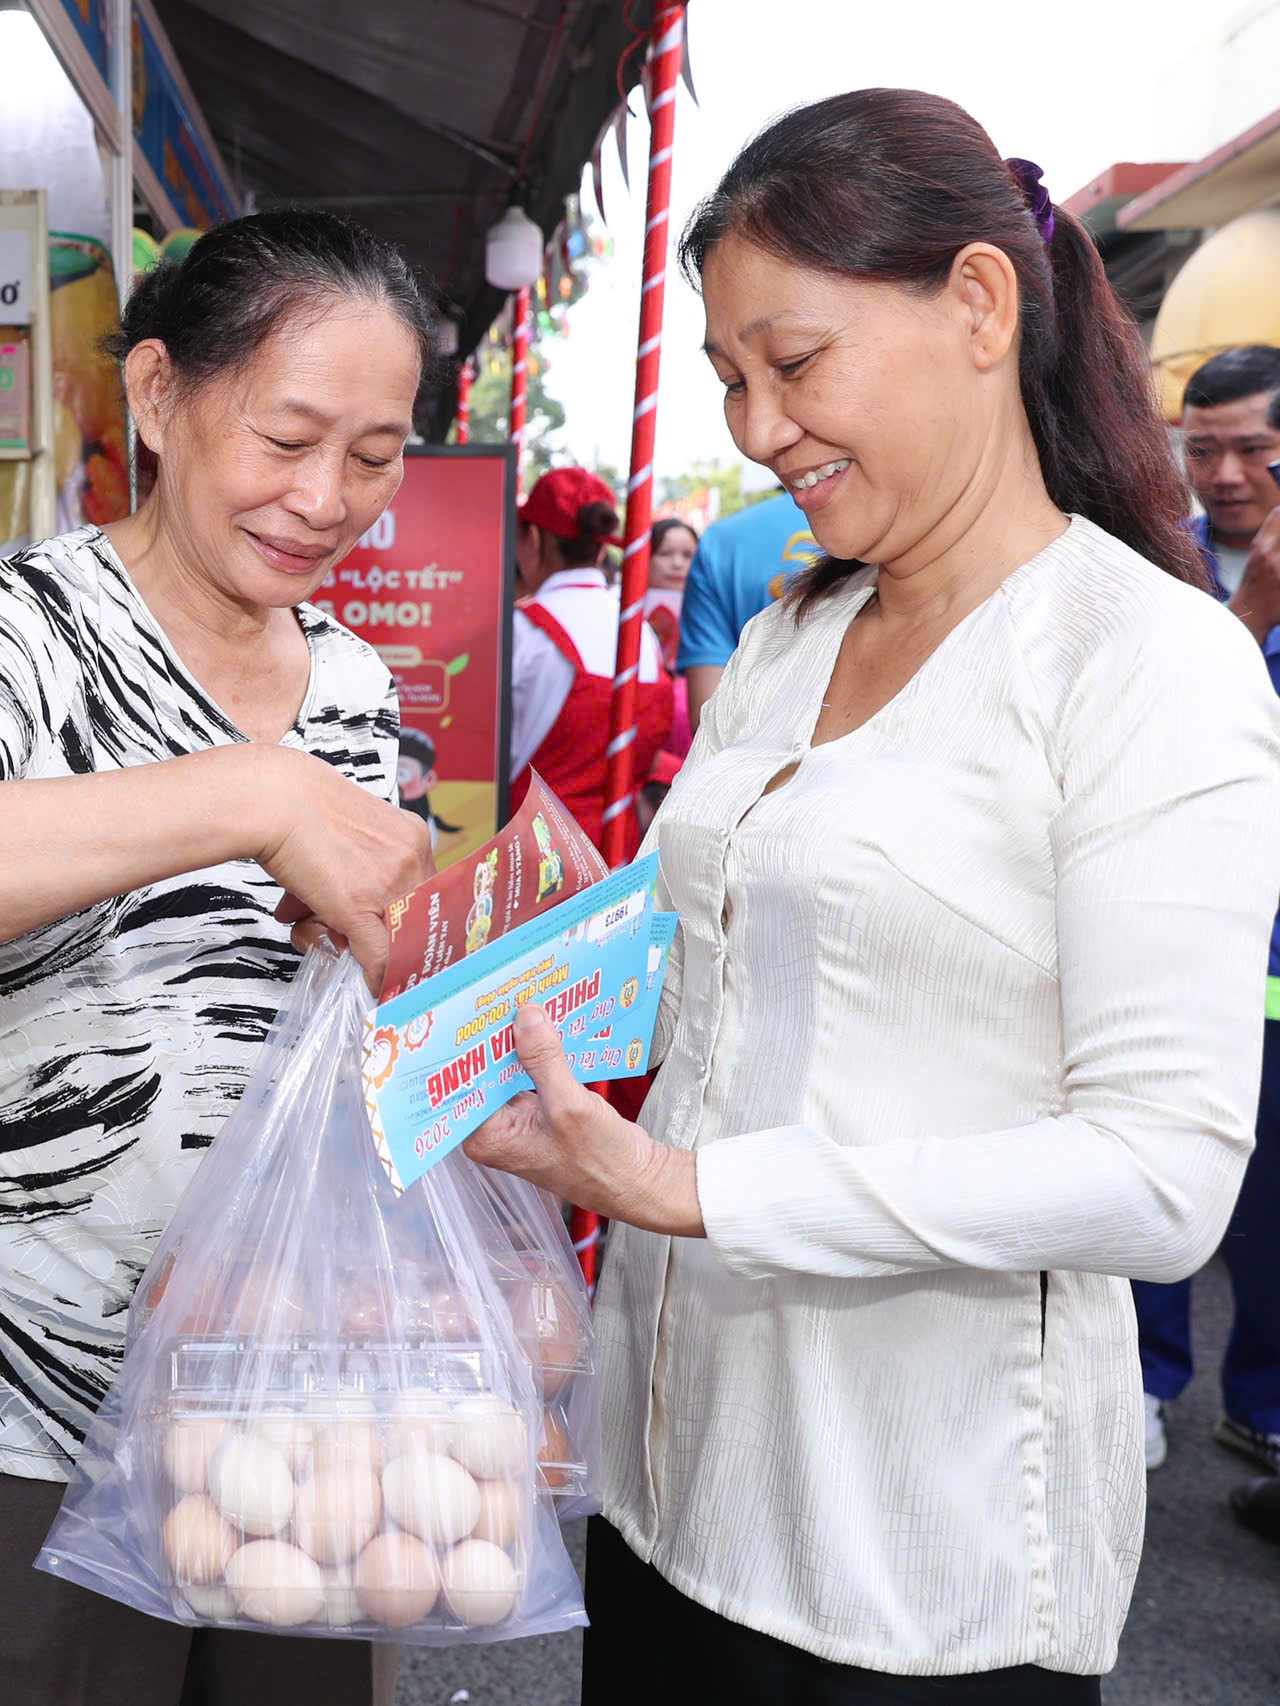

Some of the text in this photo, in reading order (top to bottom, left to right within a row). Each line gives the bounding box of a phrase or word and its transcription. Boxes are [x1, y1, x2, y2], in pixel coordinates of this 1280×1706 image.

[343, 600, 433, 628] OMO!
[605, 903, 630, 929] 19973
[538, 962, 569, 994] Mệnh
[455, 998, 512, 1046] 100.000đ
[591, 994, 615, 1018] Chợ
[491, 1022, 516, 1064] UA
[598, 1045, 622, 1066] Chợ
[426, 1039, 487, 1109] HÀNG
[453, 1086, 485, 1120] Xuân
[415, 1116, 451, 1159] 2026
